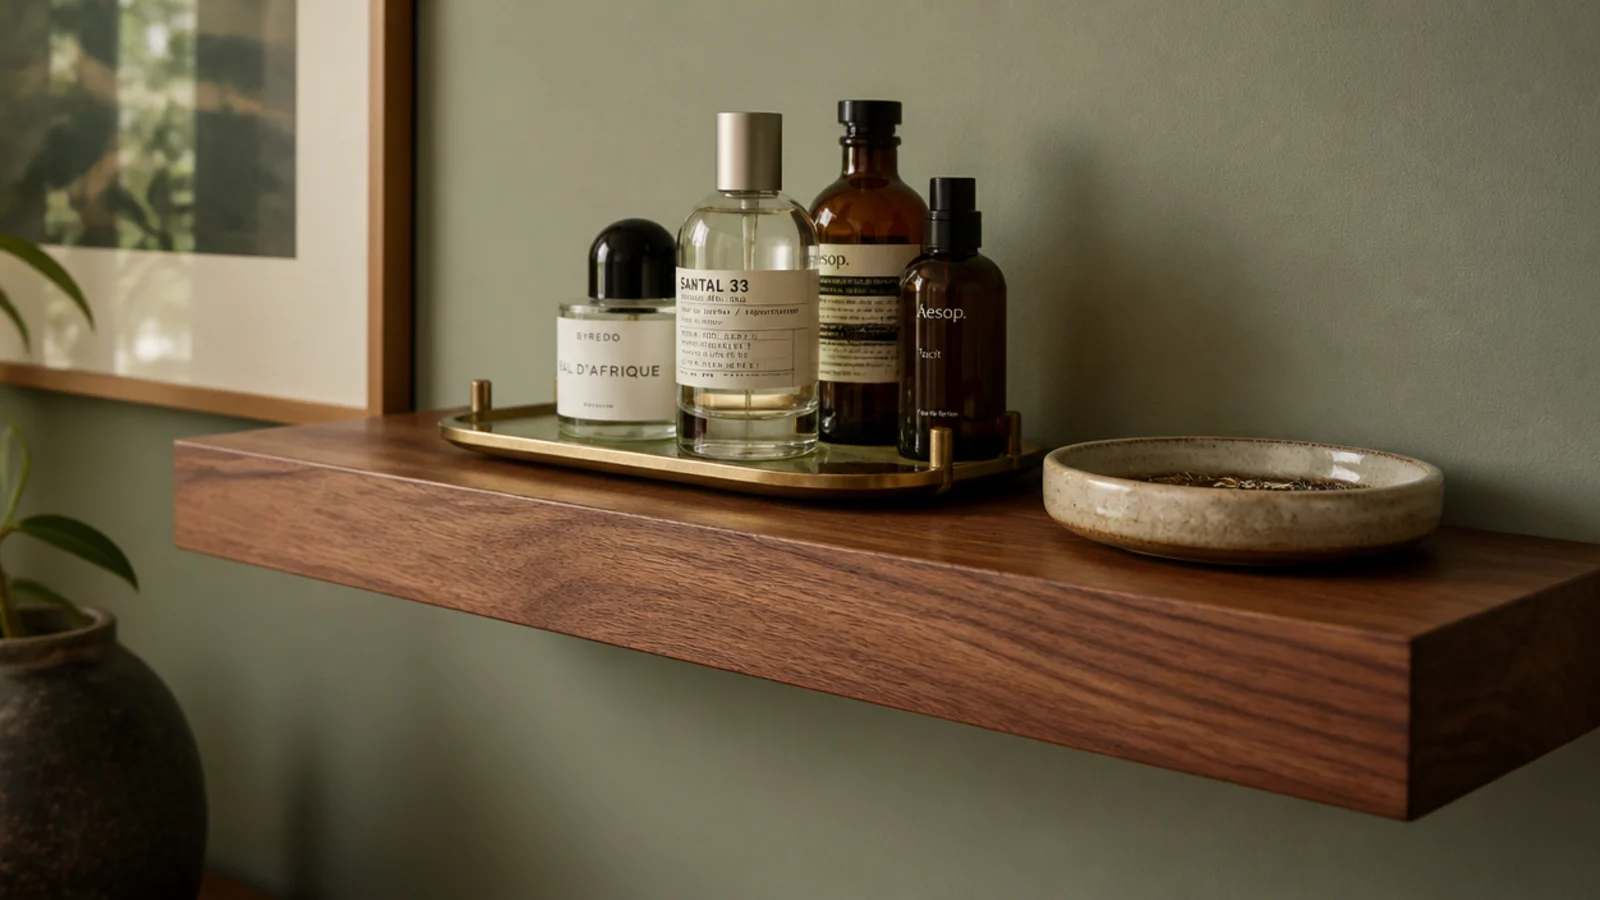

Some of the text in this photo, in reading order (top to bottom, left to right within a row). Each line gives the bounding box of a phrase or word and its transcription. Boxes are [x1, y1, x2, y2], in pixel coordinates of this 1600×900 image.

[680, 277, 749, 293] SANTAL 33
[576, 332, 621, 342] BYREDO
[576, 363, 660, 379] D'AFRIQUE
